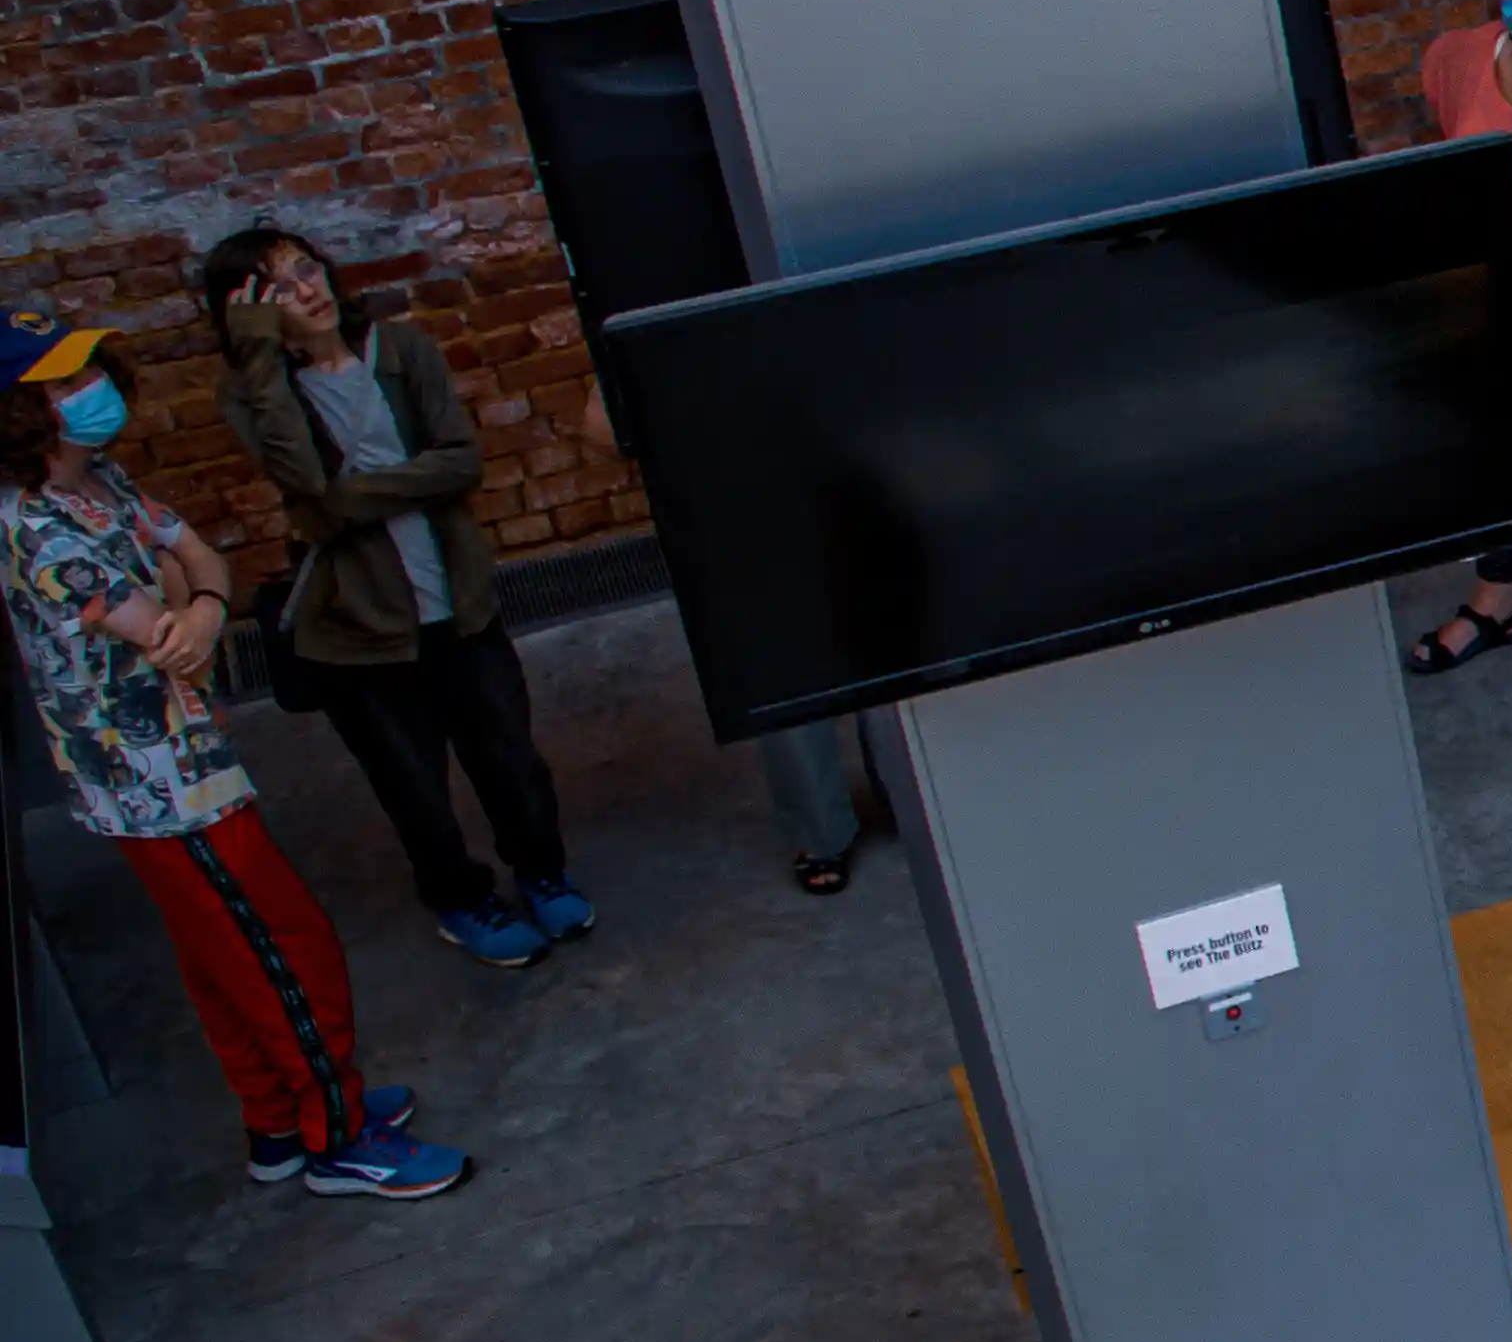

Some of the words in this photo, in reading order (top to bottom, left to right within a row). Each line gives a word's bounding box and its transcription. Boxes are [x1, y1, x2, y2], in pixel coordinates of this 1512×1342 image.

[1166, 943, 1205, 962] Press
[1208, 929, 1252, 949] button
[1254, 924, 1269, 935] to
[1179, 958, 1202, 972] see
[1206, 949, 1230, 963] The
[1233, 939, 1262, 955] Blitz
